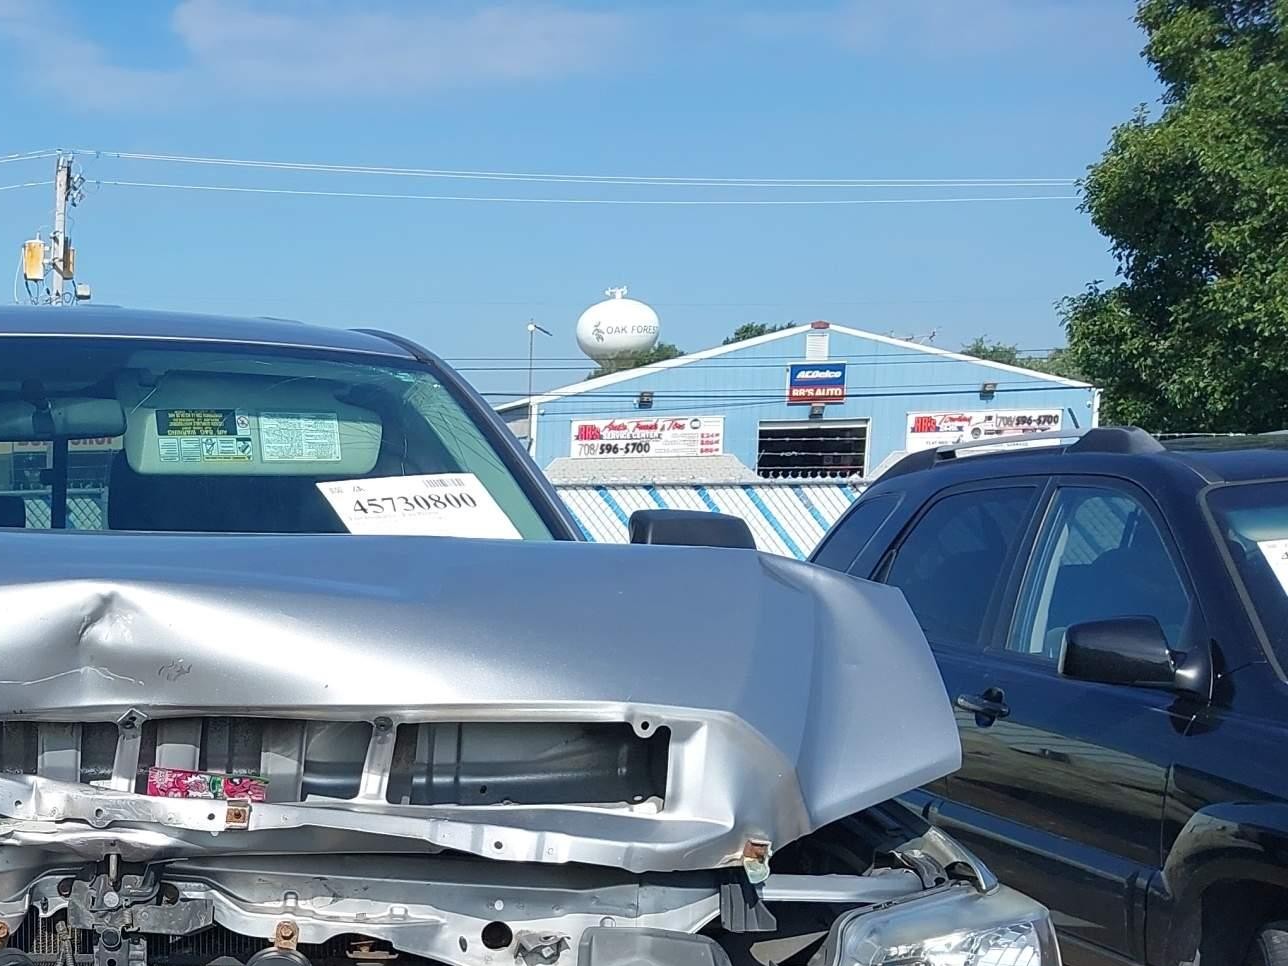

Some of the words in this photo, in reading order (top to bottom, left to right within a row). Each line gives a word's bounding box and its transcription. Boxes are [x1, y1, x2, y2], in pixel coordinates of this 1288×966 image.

[606, 326, 628, 335] OAK
[815, 387, 843, 396] AUTO
[353, 492, 477, 515] 45730800
